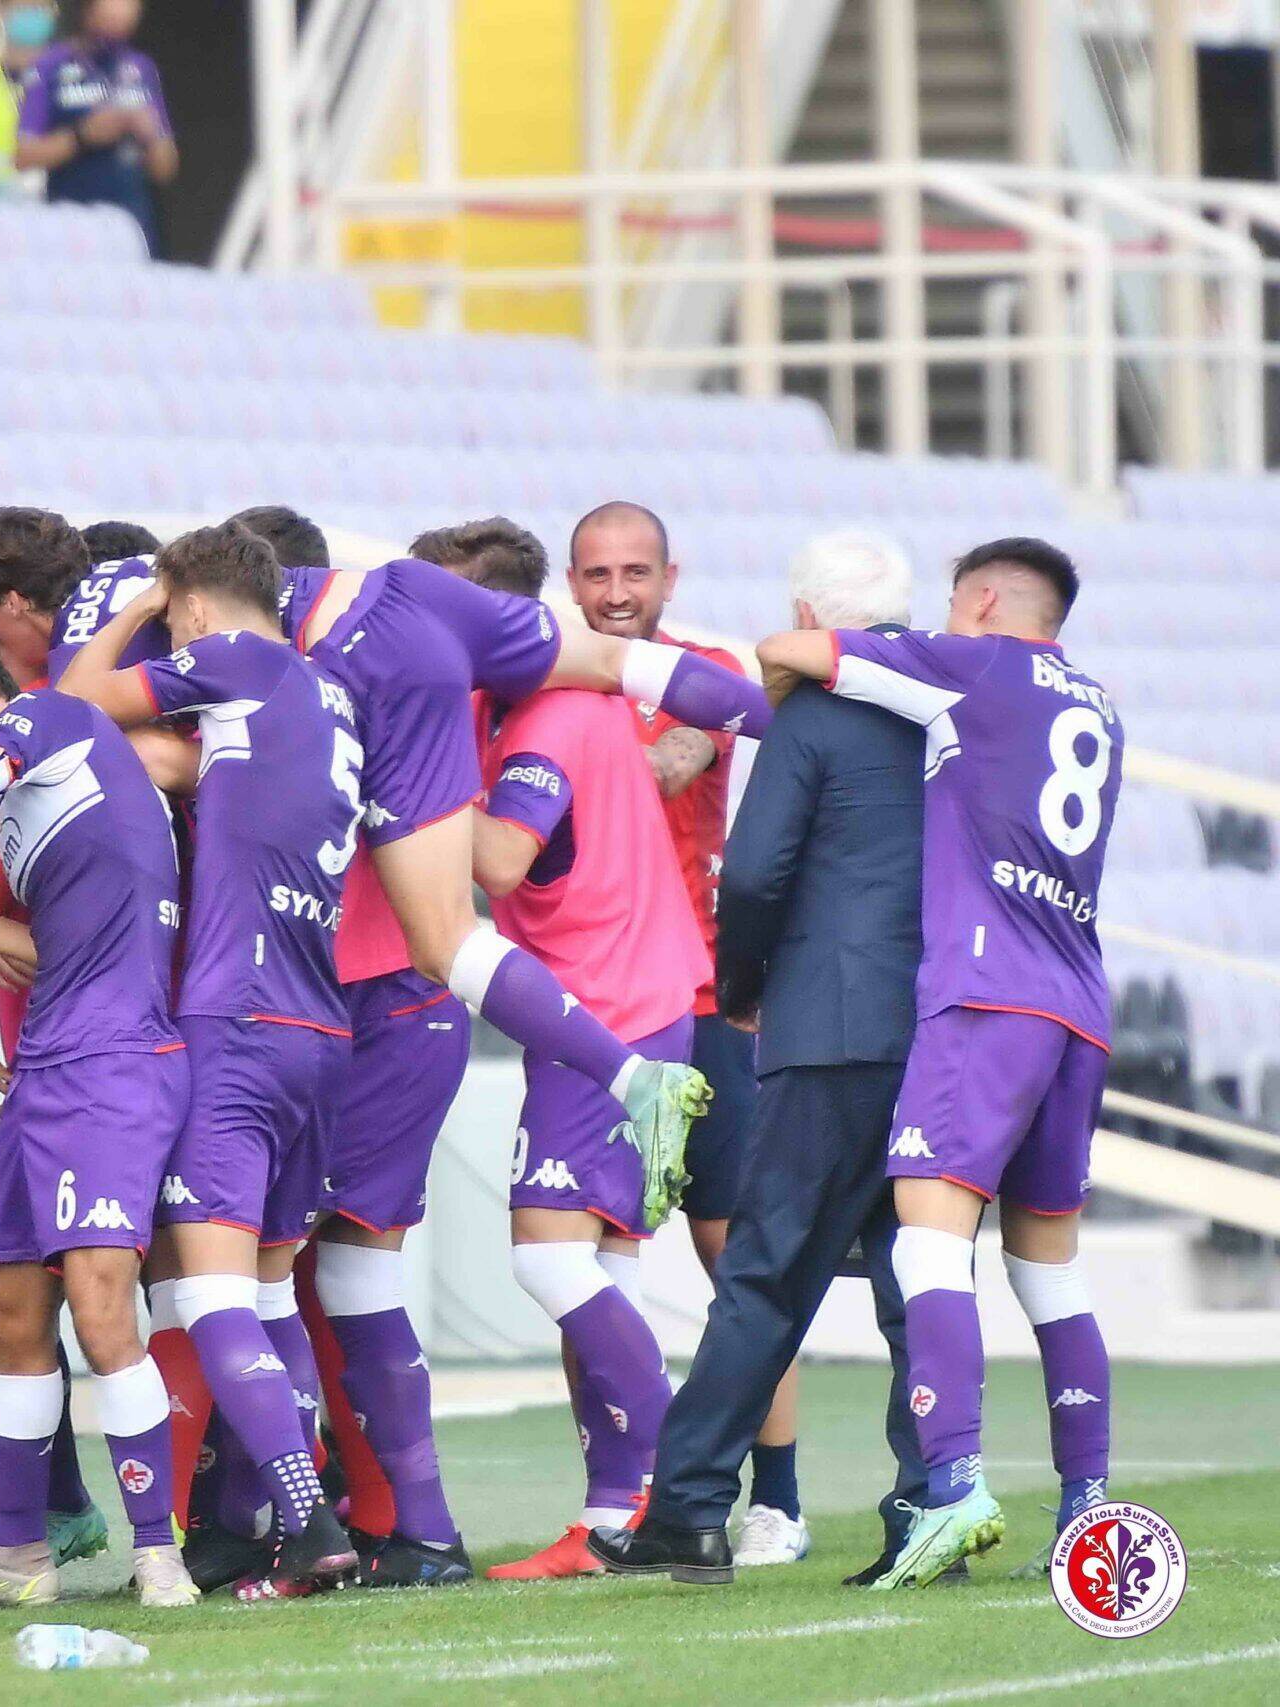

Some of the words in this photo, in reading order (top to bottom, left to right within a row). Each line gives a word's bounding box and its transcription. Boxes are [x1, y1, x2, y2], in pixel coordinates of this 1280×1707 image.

[317, 726, 365, 876] 5
[1039, 706, 1111, 857] 8
[56, 1169, 77, 1231] 6
